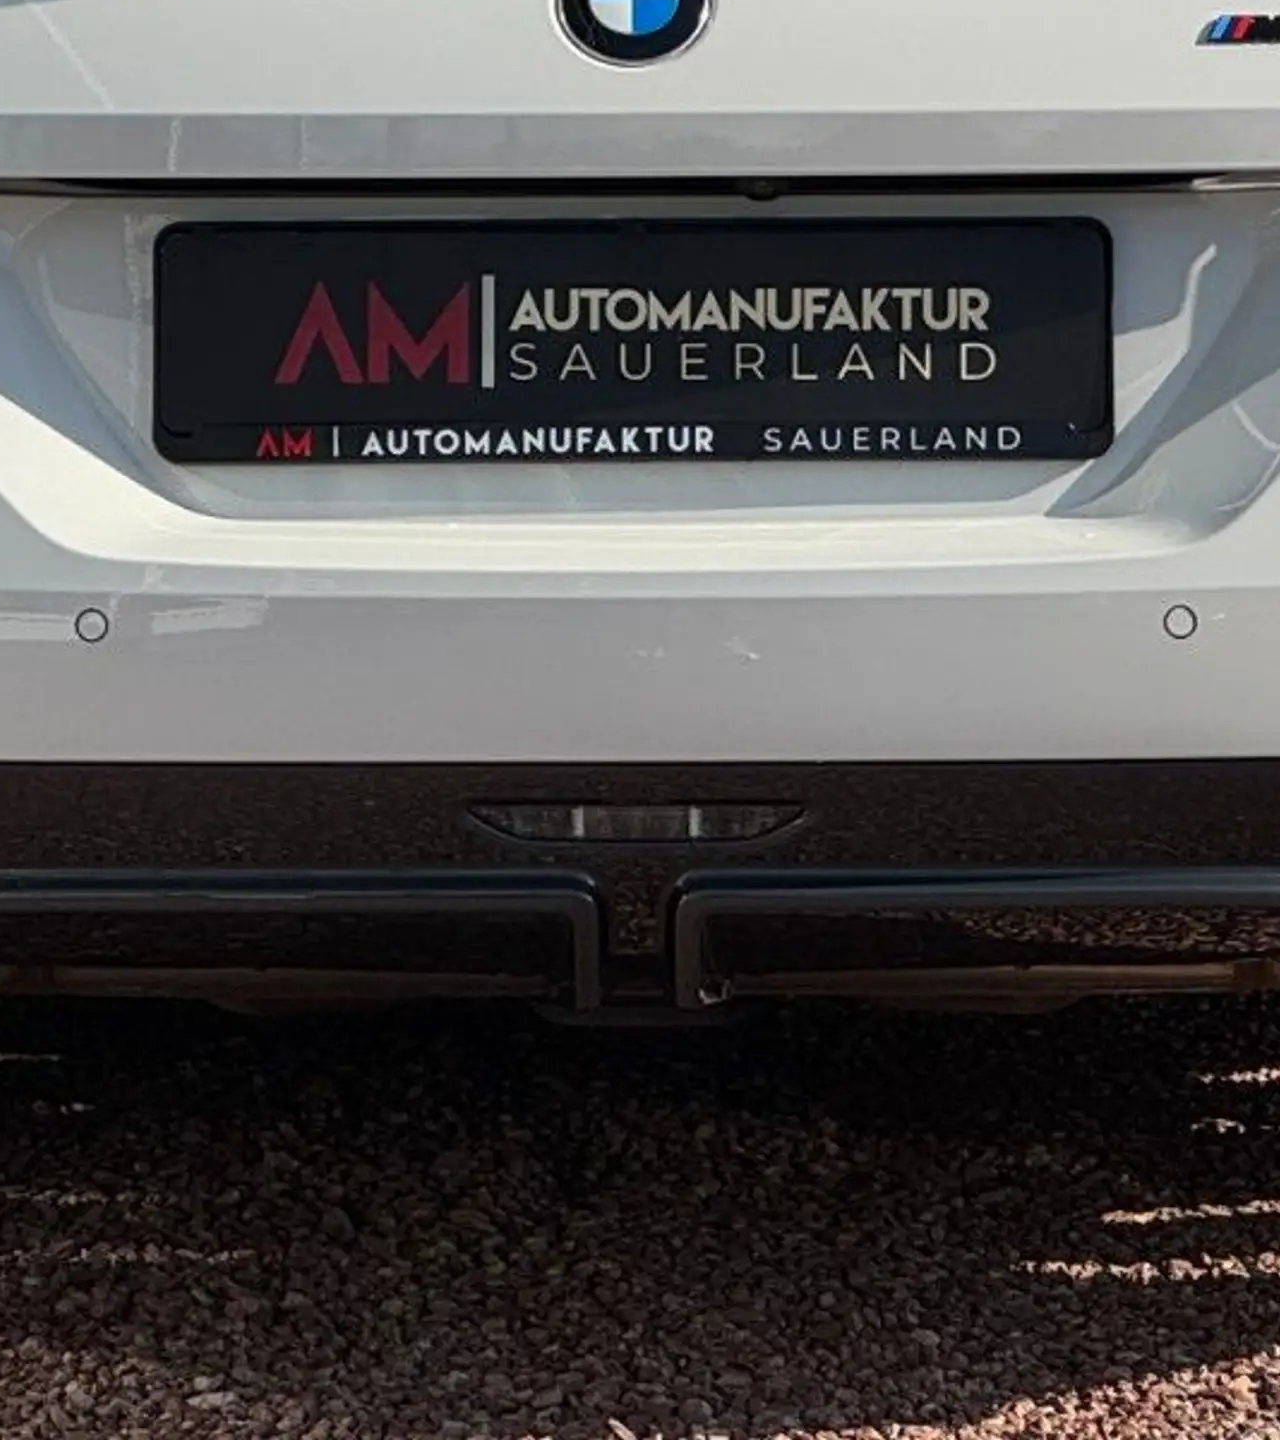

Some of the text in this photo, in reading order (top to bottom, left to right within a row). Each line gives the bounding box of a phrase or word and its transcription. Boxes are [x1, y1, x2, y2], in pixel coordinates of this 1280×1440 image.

[509, 287, 991, 332] AUTOMANUFAKTUR
[274, 281, 470, 384] AM
[510, 341, 998, 382] SAUERLAND
[256, 426, 1022, 457] AM AUTOMANUFAKTUR SAUERLAND
